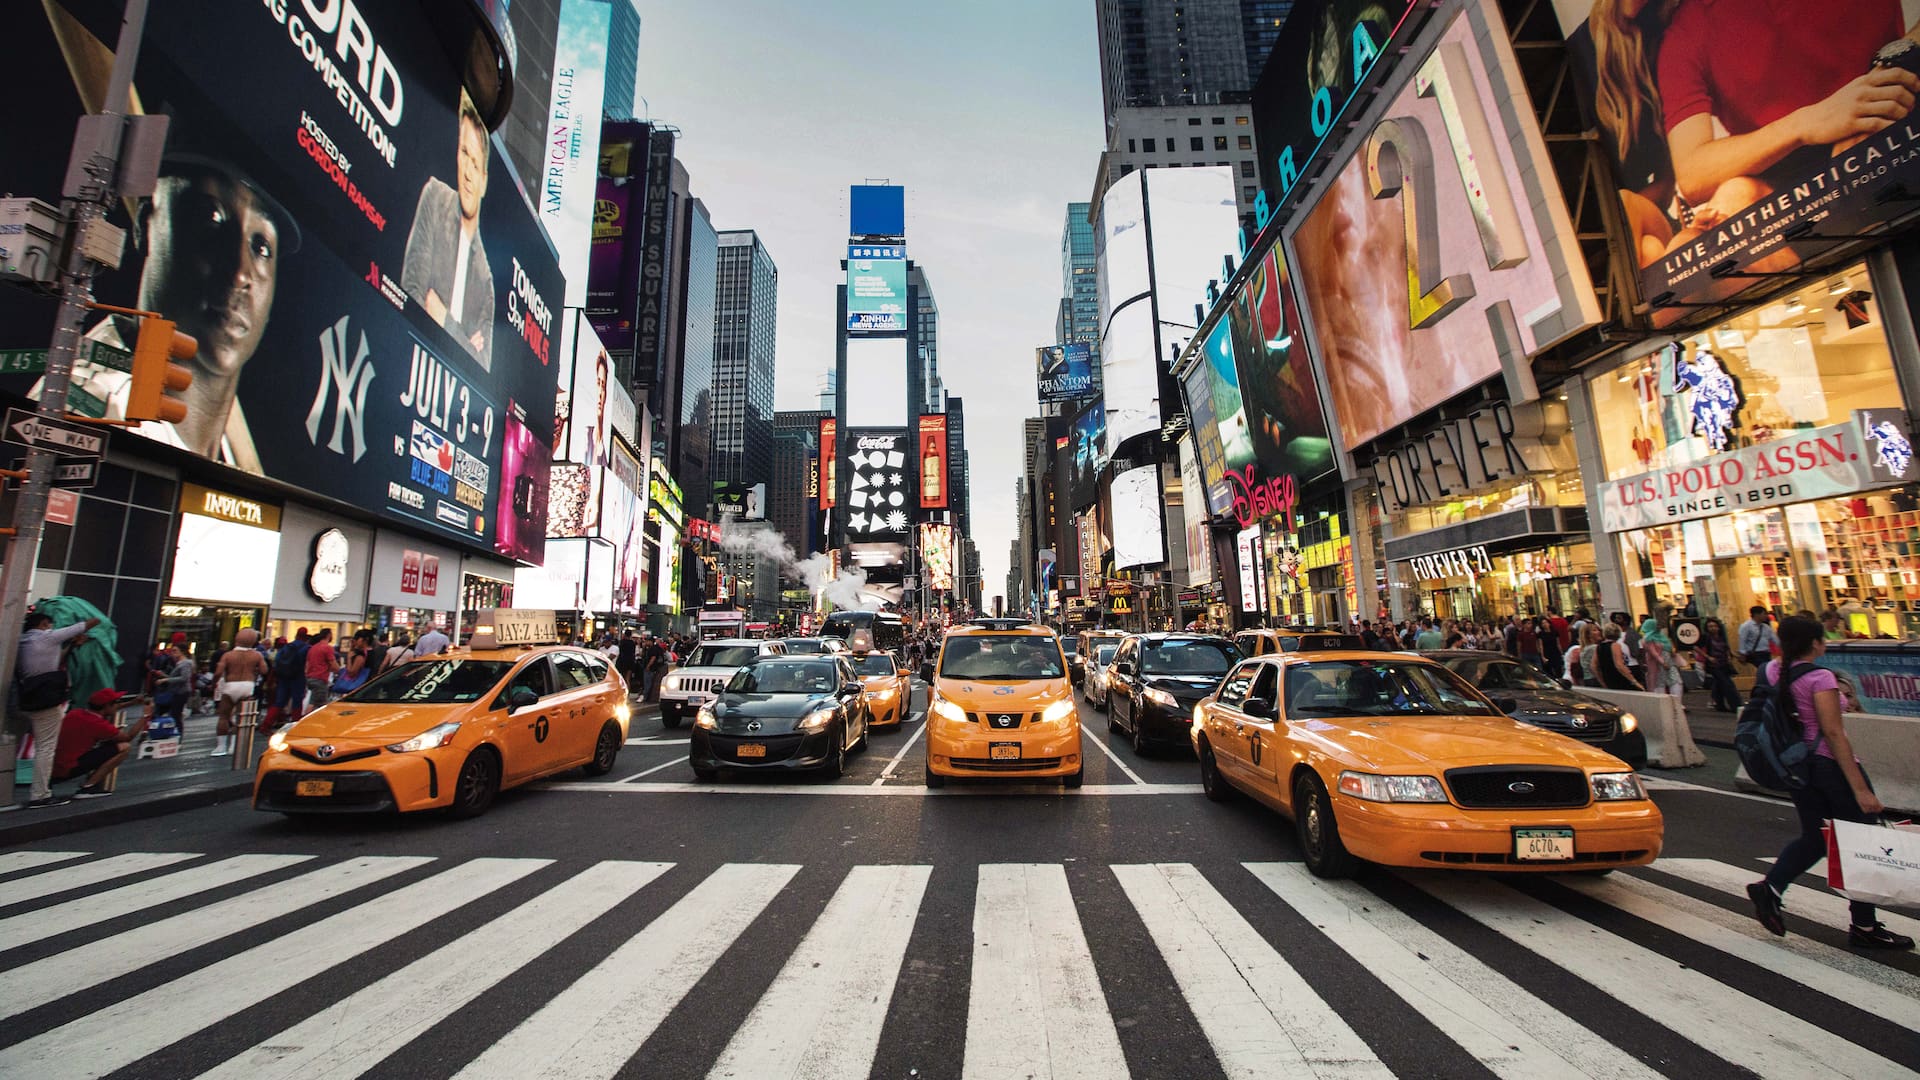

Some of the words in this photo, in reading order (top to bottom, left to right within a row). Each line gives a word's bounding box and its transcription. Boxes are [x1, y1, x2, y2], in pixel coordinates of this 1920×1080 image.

[288, 15, 397, 168] COMPETITION!
[554, 67, 575, 121] EAGLE
[301, 110, 339, 161] HOSTED
[337, 153, 352, 174] BY
[547, 124, 568, 218] AMERICAN
[570, 114, 583, 174] OUTFITTERS
[297, 127, 348, 192] GORDON
[348, 182, 386, 232] RAMSAY
[649, 152, 668, 235] TIMES
[1668, 265, 1700, 287] PAMELA
[1700, 238, 1749, 269] FLANAGAN
[1760, 212, 1796, 239] JONNY
[1798, 189, 1841, 217] LAVINE
[1852, 165, 1888, 189] POLO
[1665, 242, 1707, 274] LIVE
[512, 256, 552, 336] TONIGHT
[641, 244, 662, 354] SQUARE
[860, 314, 895, 323] XINHUA
[507, 290, 526, 338] 9PM
[523, 311, 544, 361] FOX
[541, 338, 550, 367] 5
[12, 353, 31, 370] 45
[1039, 375, 1091, 389] PHANTOM
[400, 343, 457, 433] JULY
[455, 385, 470, 444] 3
[480, 406, 494, 458] 9
[22, 423, 53, 440] ONE
[64, 432, 97, 449] WAY
[1370, 399, 1529, 515] FOREVER
[410, 457, 434, 489] BLUE
[432, 468, 450, 495] JAYS
[1619, 477, 1663, 506] U.S.
[1665, 458, 1744, 498] POLO
[1753, 432, 1858, 481] ASSN.
[203, 491, 263, 524] INVICTA
[1667, 495, 1726, 516] SINCE
[1735, 483, 1793, 505] 1890
[1080, 521, 1091, 581] PALACE
[1409, 549, 1474, 583] FOREVER
[1472, 545, 1493, 574] 21
[499, 623, 532, 642] JAY:Z
[533, 623, 557, 640] 4:44
[1323, 639, 1341, 648] 6C70
[1855, 851, 1898, 865] AMERICAN
